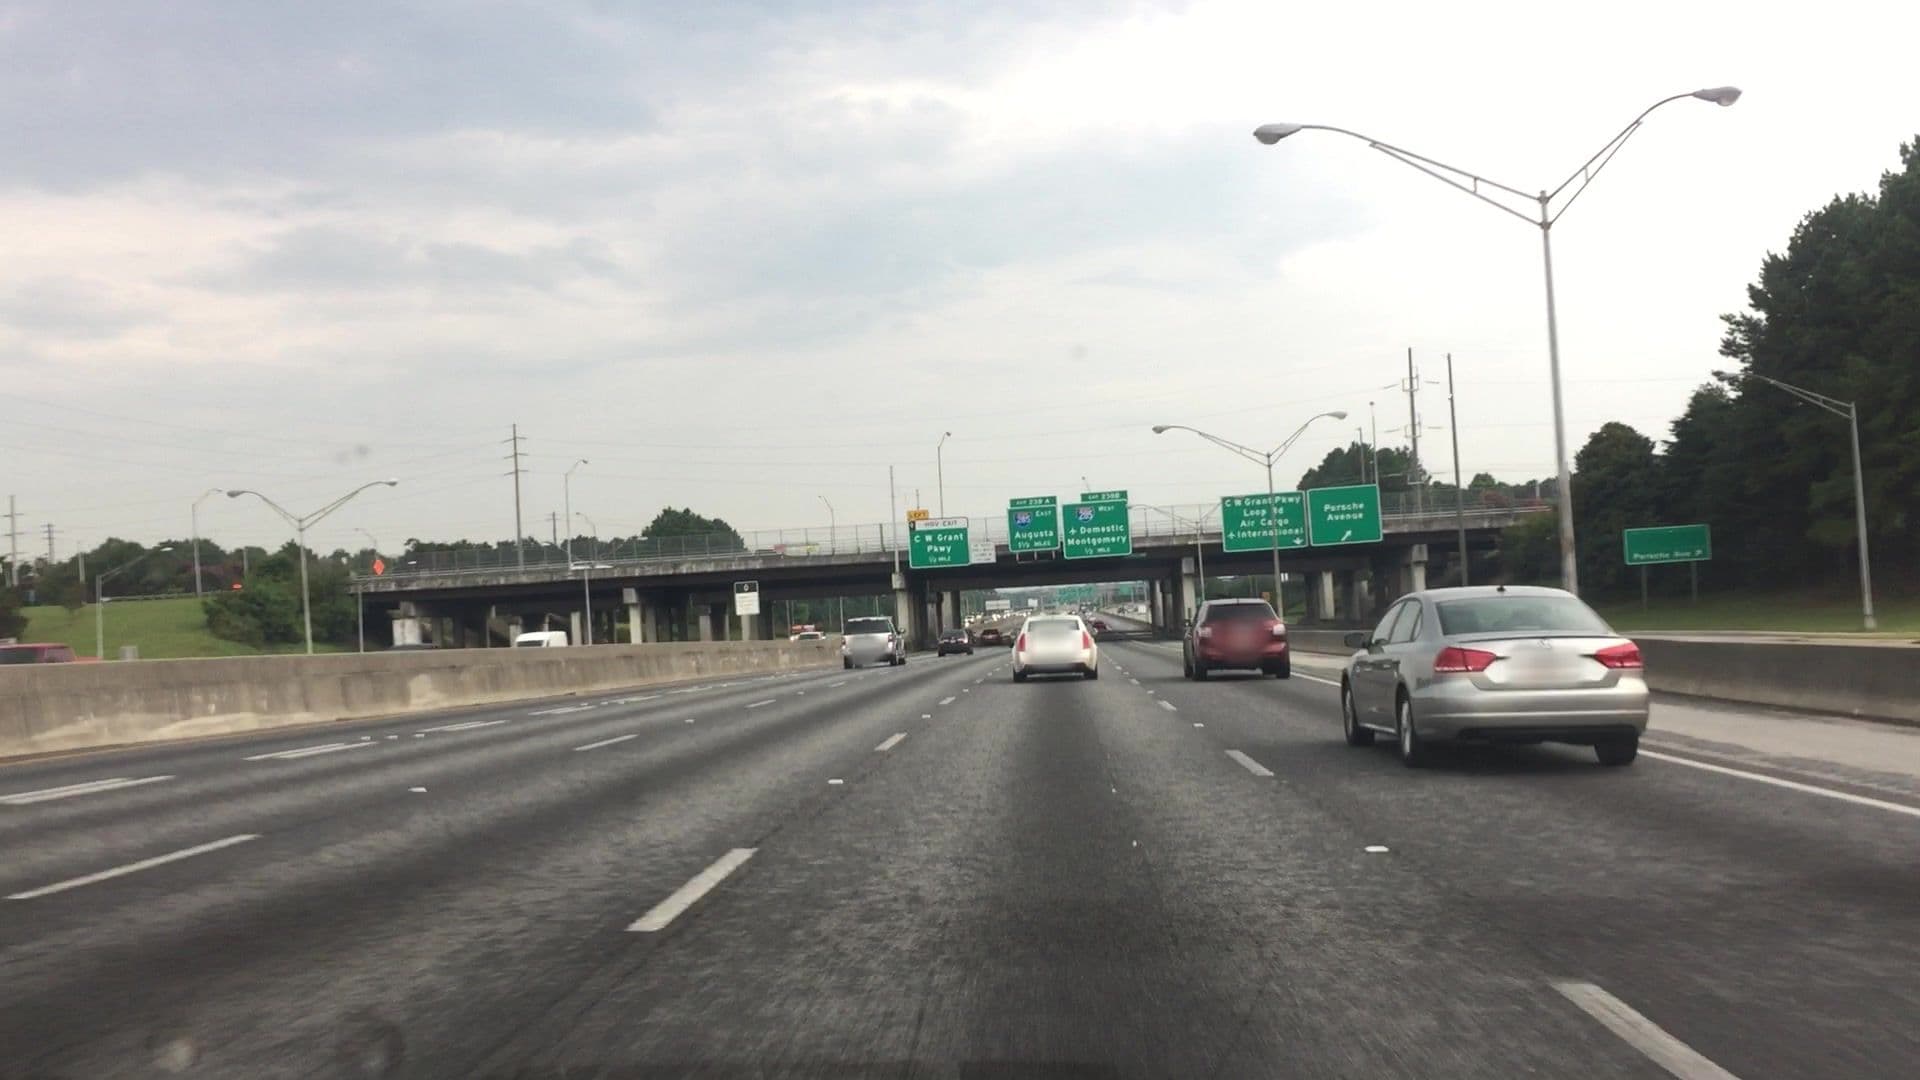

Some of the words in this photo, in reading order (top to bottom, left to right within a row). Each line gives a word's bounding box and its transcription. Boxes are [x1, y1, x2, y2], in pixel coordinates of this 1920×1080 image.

[1225, 499, 1231, 507] C
[1274, 495, 1301, 504] Pkwy
[1323, 502, 1364, 512] Porsche
[1243, 508, 1267, 517] Loop
[1327, 512, 1363, 521] Avenue
[1240, 519, 1255, 527] Air
[1080, 524, 1124, 534] Domestic
[914, 535, 921, 543] C
[937, 532, 963, 541] Grant
[1014, 530, 1054, 540] Augusta
[1067, 535, 1127, 546] Montgomery
[927, 545, 951, 553] Pkwy
